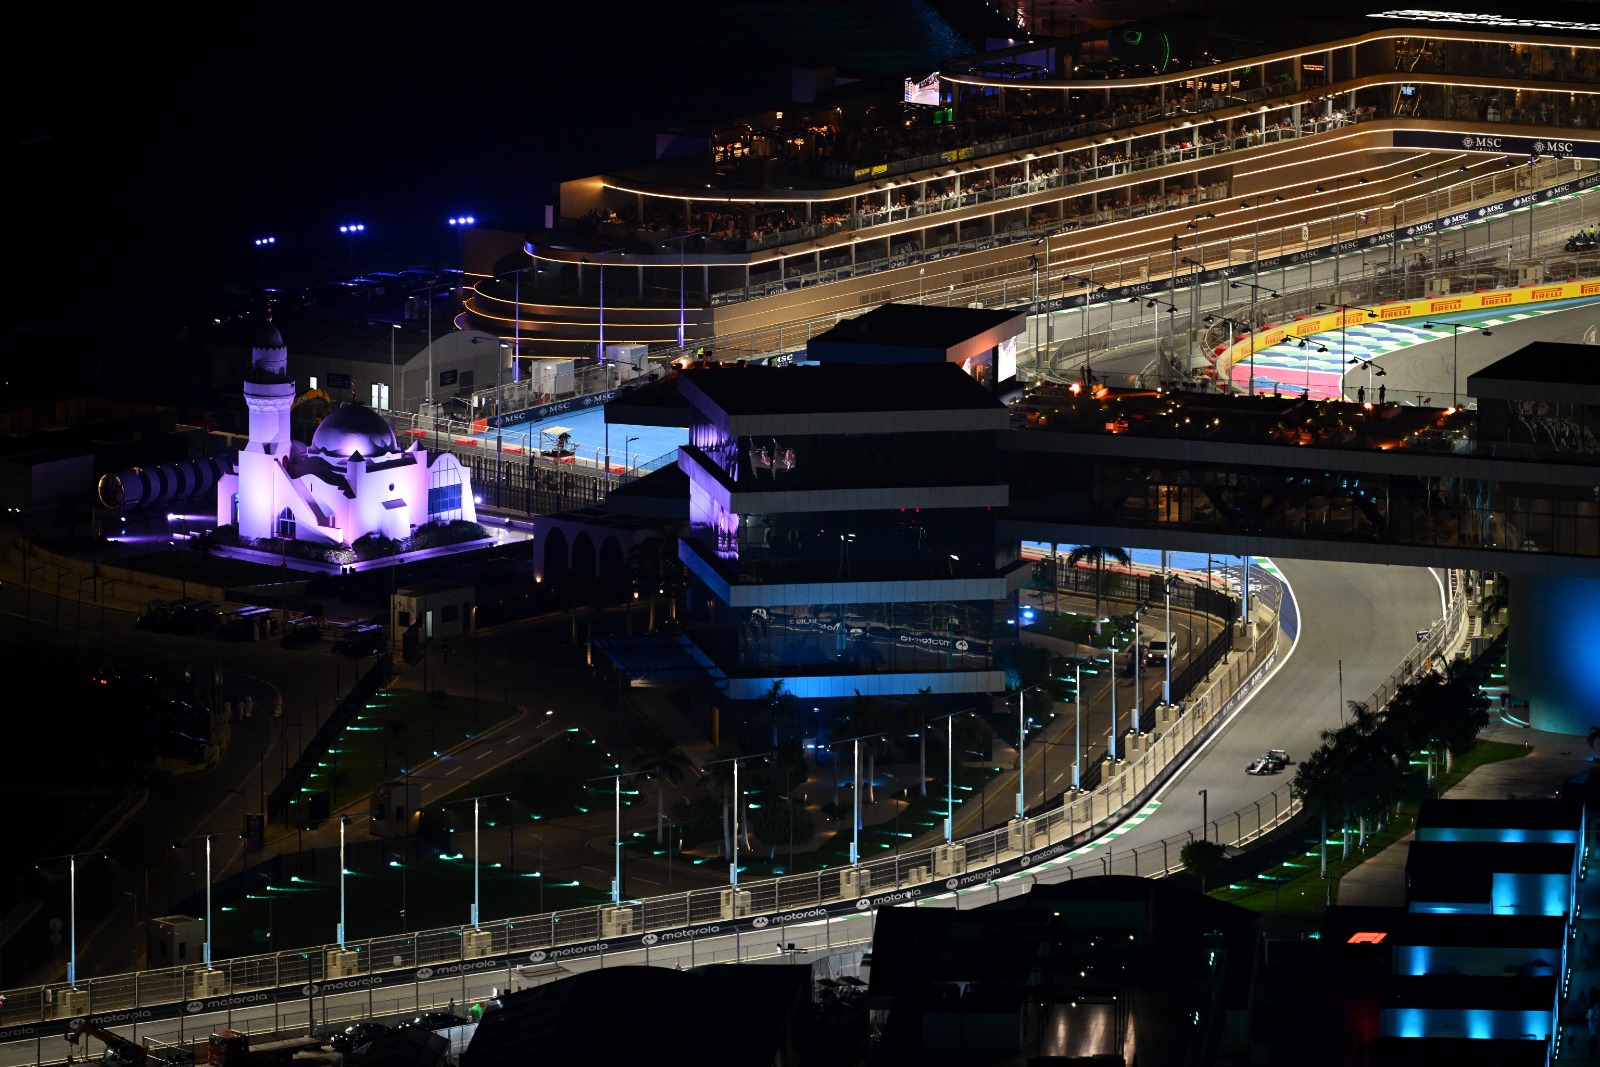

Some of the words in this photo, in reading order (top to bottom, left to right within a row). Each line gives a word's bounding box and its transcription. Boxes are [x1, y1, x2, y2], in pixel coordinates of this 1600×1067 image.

[1475, 136, 1502, 148] MSC
[1547, 142, 1573, 152] MSC
[1586, 175, 1600, 184] MSC
[1554, 184, 1570, 194] MSC
[1521, 194, 1538, 204] MSC
[1486, 203, 1504, 214] MSC
[1452, 212, 1469, 223] MSC
[1415, 222, 1434, 233] MSC
[1340, 240, 1359, 251] MSC
[1300, 249, 1320, 260] MSC
[1260, 258, 1280, 268] MSC
[1131, 283, 1152, 294] MSC
[1532, 287, 1562, 300] PIRELLI
[1088, 291, 1108, 302] MSC
[1482, 293, 1512, 306] PIRELLI
[1040, 300, 1062, 310] MSC
[1431, 299, 1462, 312] PIRELLI
[1381, 305, 1411, 318] PIRELLI
[1296, 320, 1320, 336] PIRELLI
[550, 402, 570, 413] MSC
[505, 412, 526, 423] MSC
[1032, 844, 1064, 862] motorola
[960, 868, 1000, 884] motorola
[772, 908, 827, 924] motorola
[662, 926, 720, 940] motorola
[550, 943, 608, 958] motorola
[436, 960, 496, 974] motorola
[322, 976, 382, 991] motorola
[208, 994, 268, 1008] motorola
[90, 1010, 152, 1024] motorola
